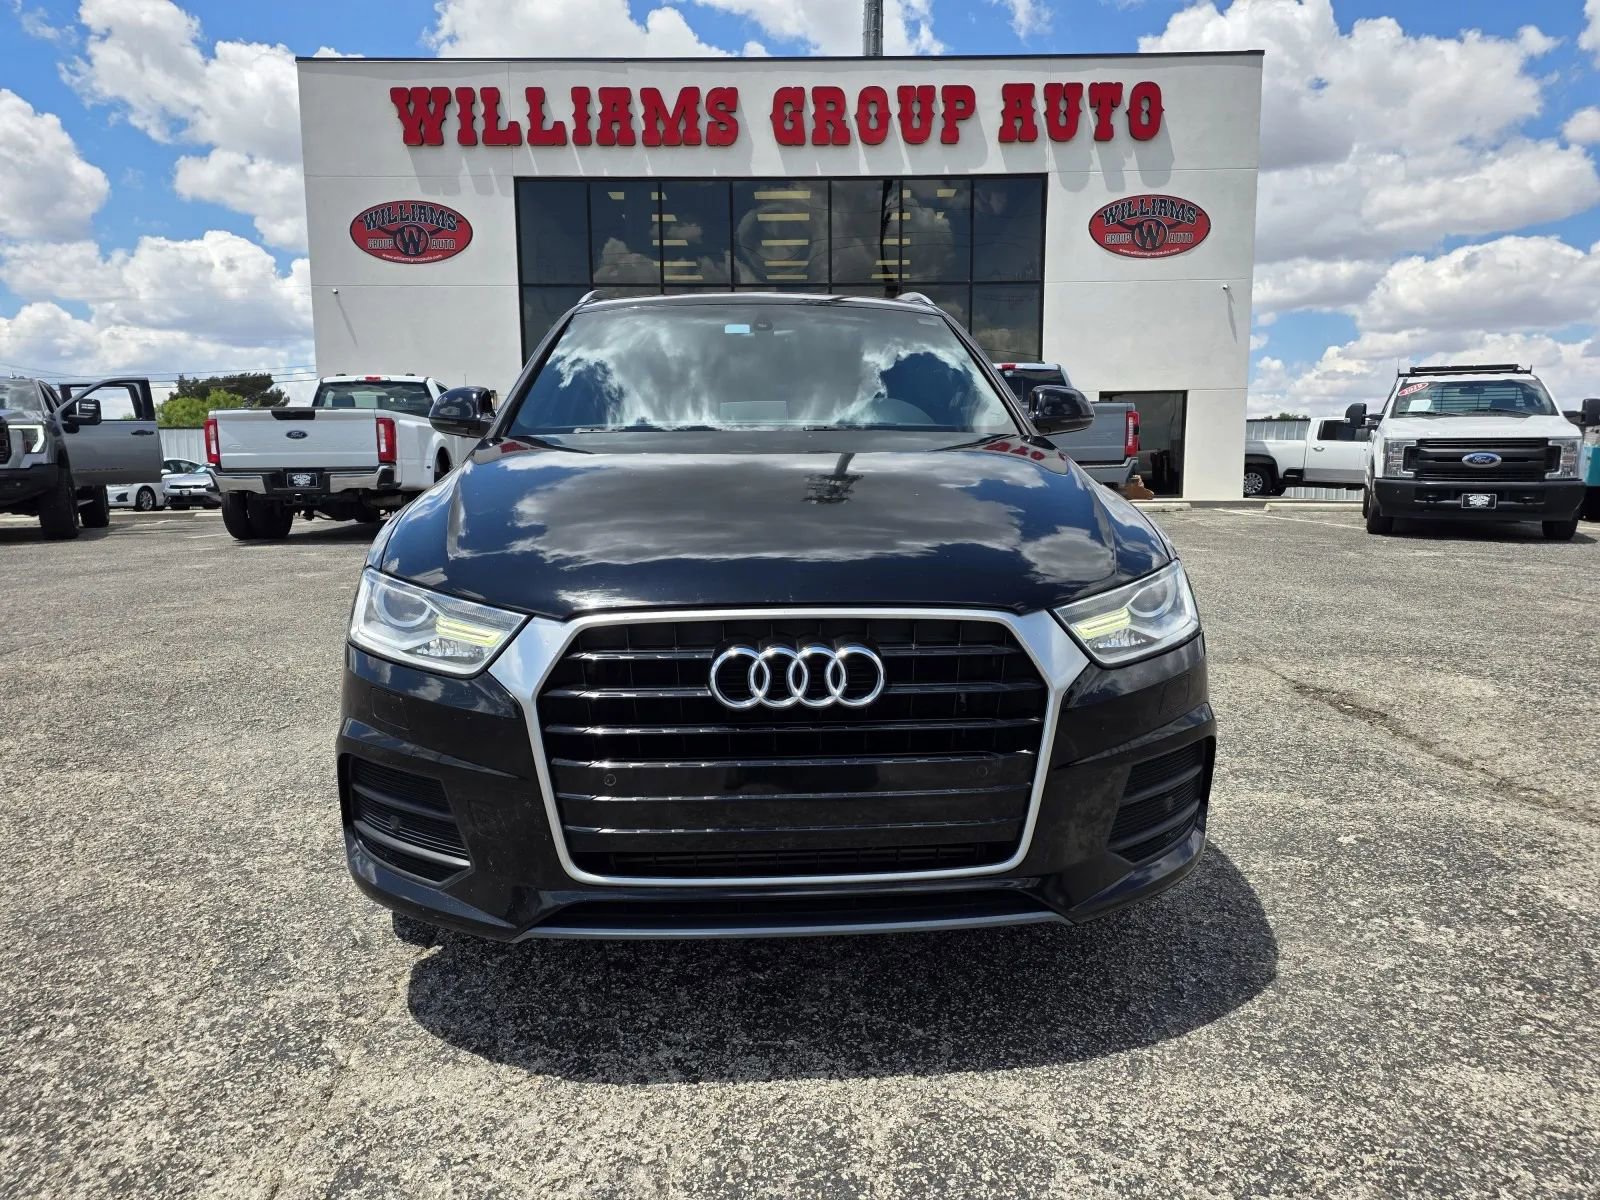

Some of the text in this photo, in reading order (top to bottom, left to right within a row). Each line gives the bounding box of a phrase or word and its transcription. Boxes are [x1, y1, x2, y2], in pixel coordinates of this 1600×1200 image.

[390, 81, 1165, 146] WILLIAMS GROUP AUTO
[363, 204, 457, 231] WILLIAMS
[1103, 198, 1196, 226] WILLIAMS
[367, 238, 456, 250] GROUP AUTO
[398, 225, 424, 256] W
[1105, 232, 1193, 244] GROUP AUTO
[1138, 219, 1162, 249] W
